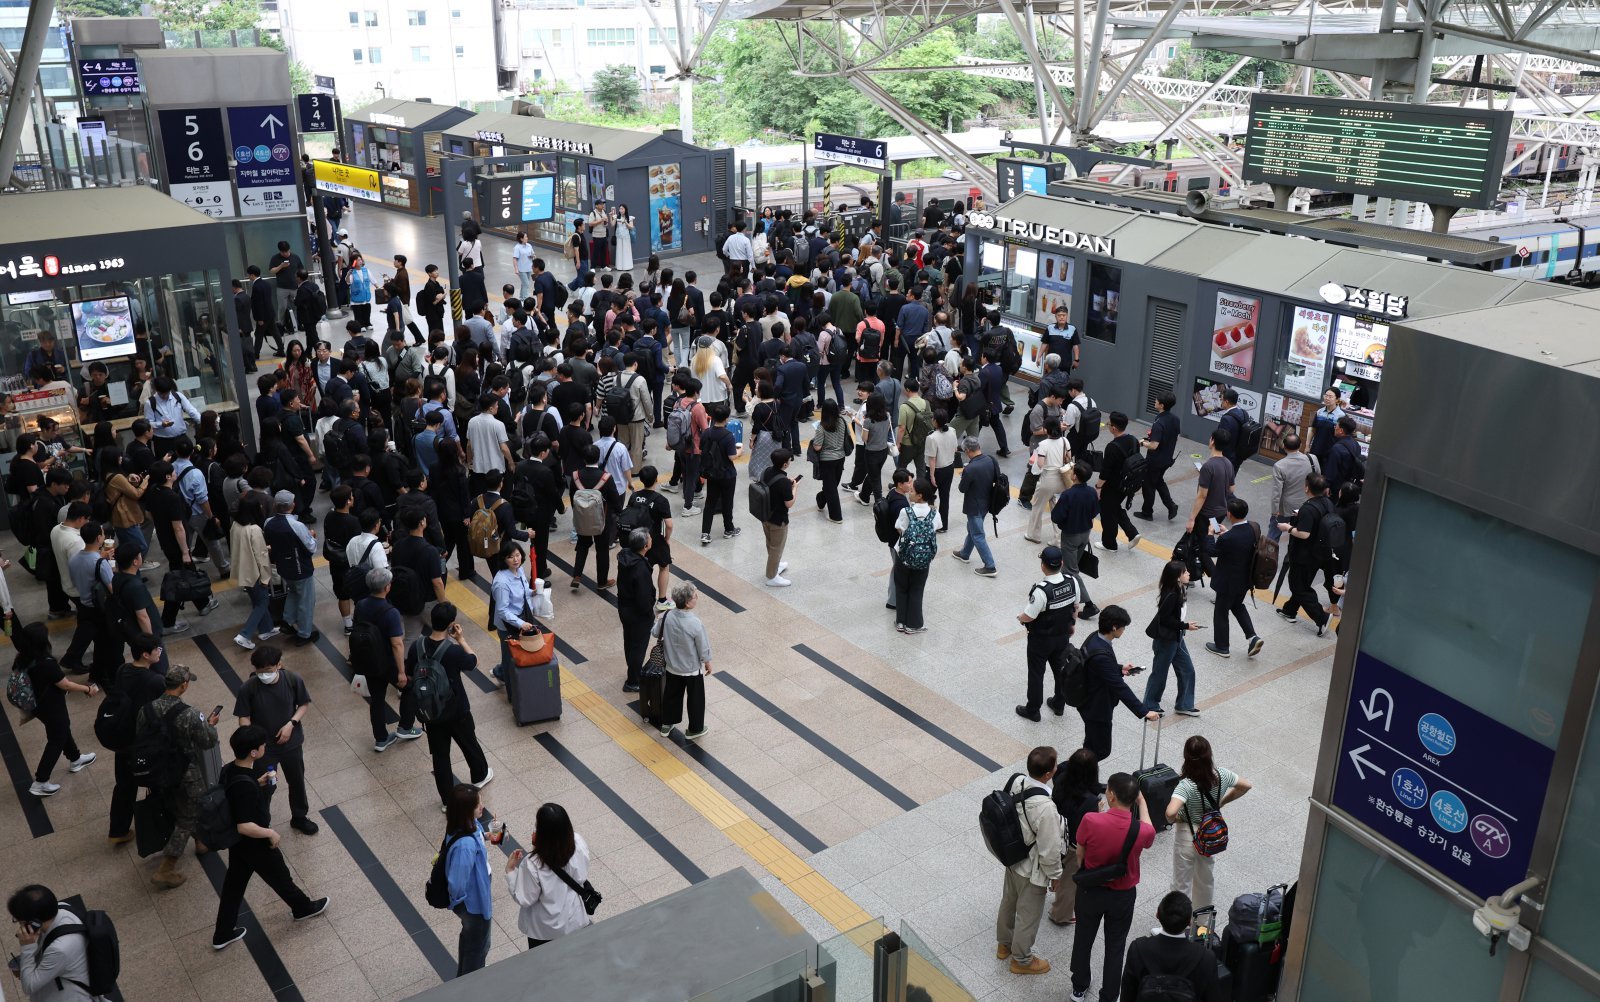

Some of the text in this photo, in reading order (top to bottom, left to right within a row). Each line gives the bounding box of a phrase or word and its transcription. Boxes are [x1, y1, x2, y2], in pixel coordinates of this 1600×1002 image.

[95, 63, 101, 71] 4
[311, 97, 319, 107] 3
[312, 110, 321, 120] 4
[185, 115, 199, 135] 5
[816, 135, 823, 148] 5
[875, 144, 883, 158] 6
[841, 138, 856, 149] 타는 곳
[188, 141, 203, 161] 6
[186, 165, 210, 174] 타는 곳
[240, 169, 259, 177] 지하철
[1008, 187, 1015, 199] 6
[501, 207, 511, 219] 6
[995, 215, 1114, 257] TRUEDAN
[61, 263, 97, 275] since
[1219, 297, 1255, 313] Strawberry
[1348, 288, 1406, 317] 소월당
[1353, 366, 1371, 378] 시원한
[1421, 721, 1454, 746] 공항철도
[1422, 752, 1441, 767] AREX
[1396, 774, 1425, 801] 1호선
[1400, 791, 1412, 802] Line
[1434, 798, 1465, 825] 4호선
[1439, 814, 1452, 827] Line
[1475, 820, 1507, 845] GTX
[1417, 825, 1448, 851] 승강기
[1452, 845, 1473, 866] 없음
[1482, 838, 1493, 851] A
